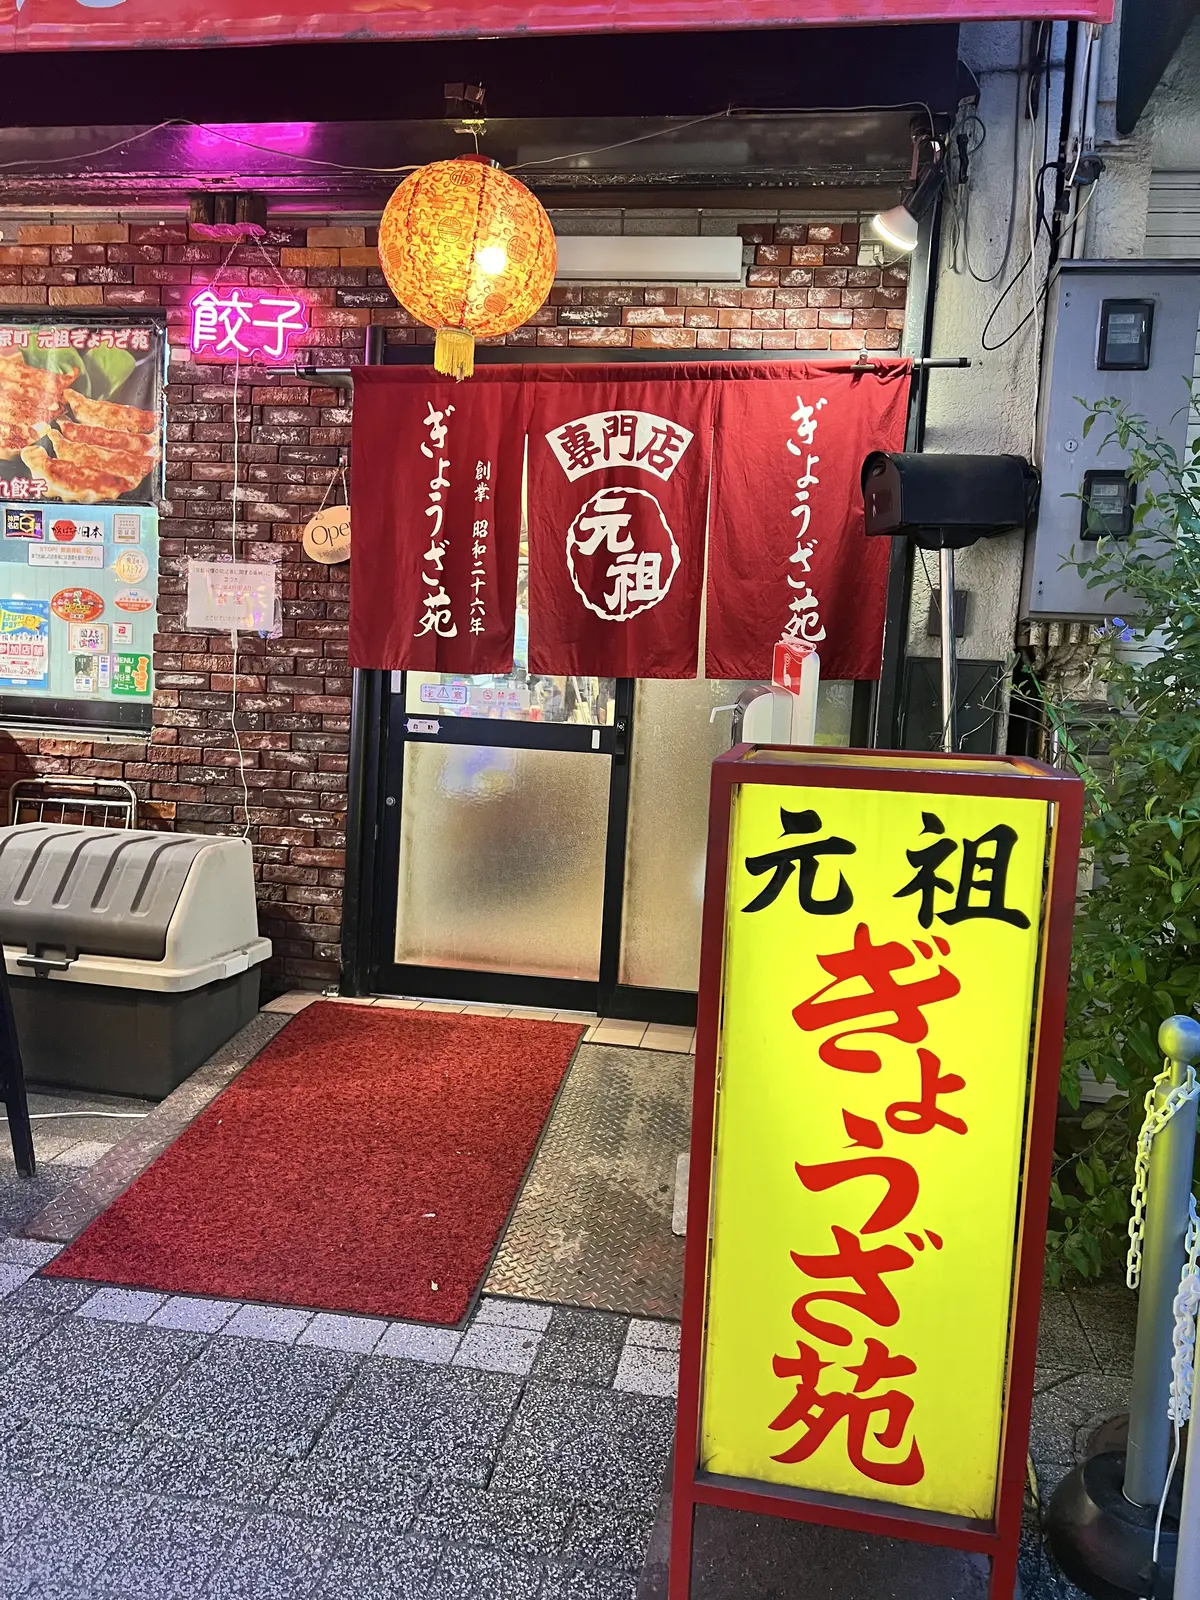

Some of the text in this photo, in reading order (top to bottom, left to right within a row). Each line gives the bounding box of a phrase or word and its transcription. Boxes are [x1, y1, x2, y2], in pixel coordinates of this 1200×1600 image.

[37, 329, 149, 349] 元祖ぎょうざ苑
[192, 291, 304, 356] 餃子
[311, 521, 351, 547] Ope
[413, 400, 458, 638] ぎょうざ苑
[468, 460, 492, 636] 創業 昭和二十六年
[575, 496, 663, 616] 元祖
[780, 395, 828, 643] ぎょうざ苑
[114, 656, 135, 664] MENU
[741, 805, 1033, 931] 元祖
[768, 921, 969, 1487] ぎょうざ苑
